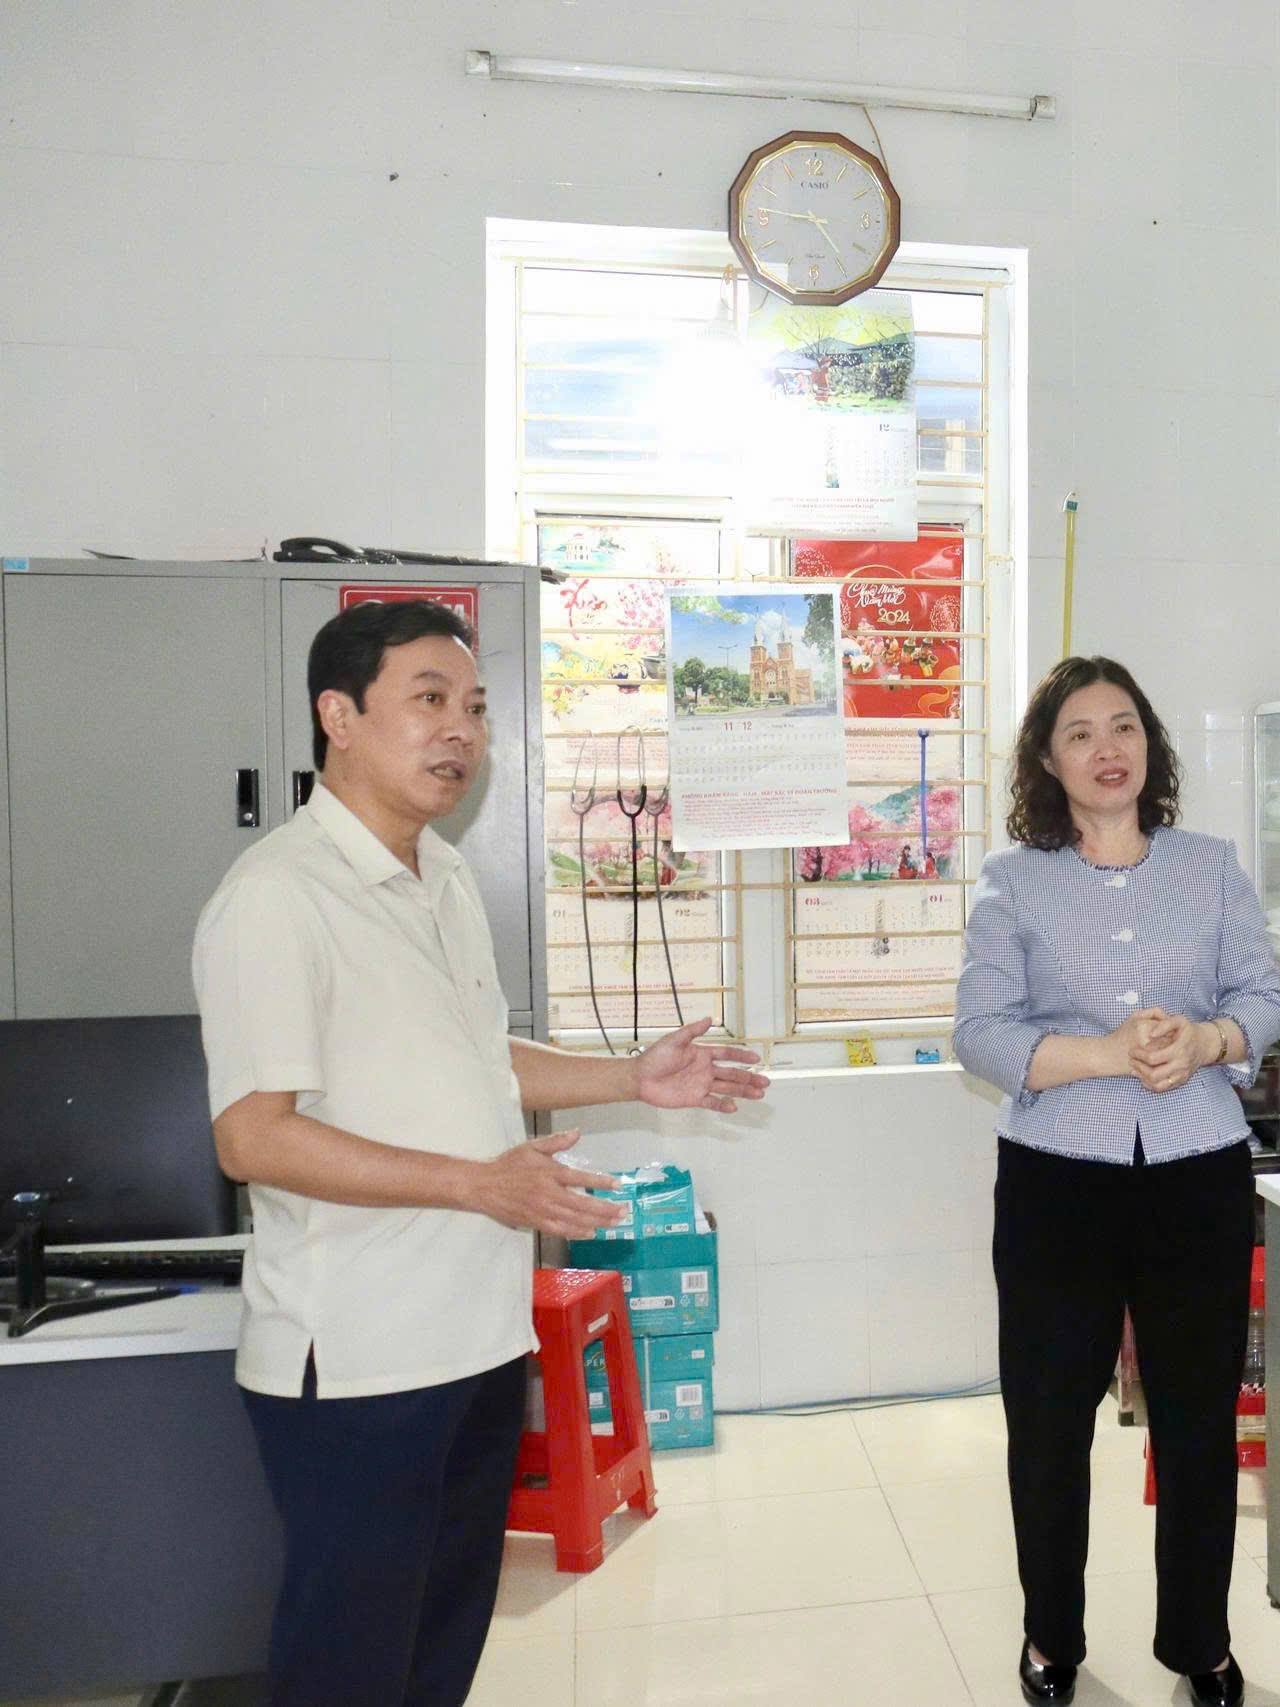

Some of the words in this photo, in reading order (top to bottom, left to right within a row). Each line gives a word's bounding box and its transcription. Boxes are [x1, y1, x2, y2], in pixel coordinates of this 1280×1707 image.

[800, 181, 829, 190] CASIO
[877, 608, 911, 626] 2024
[724, 721, 733, 731] 11
[743, 720, 753, 731] 12
